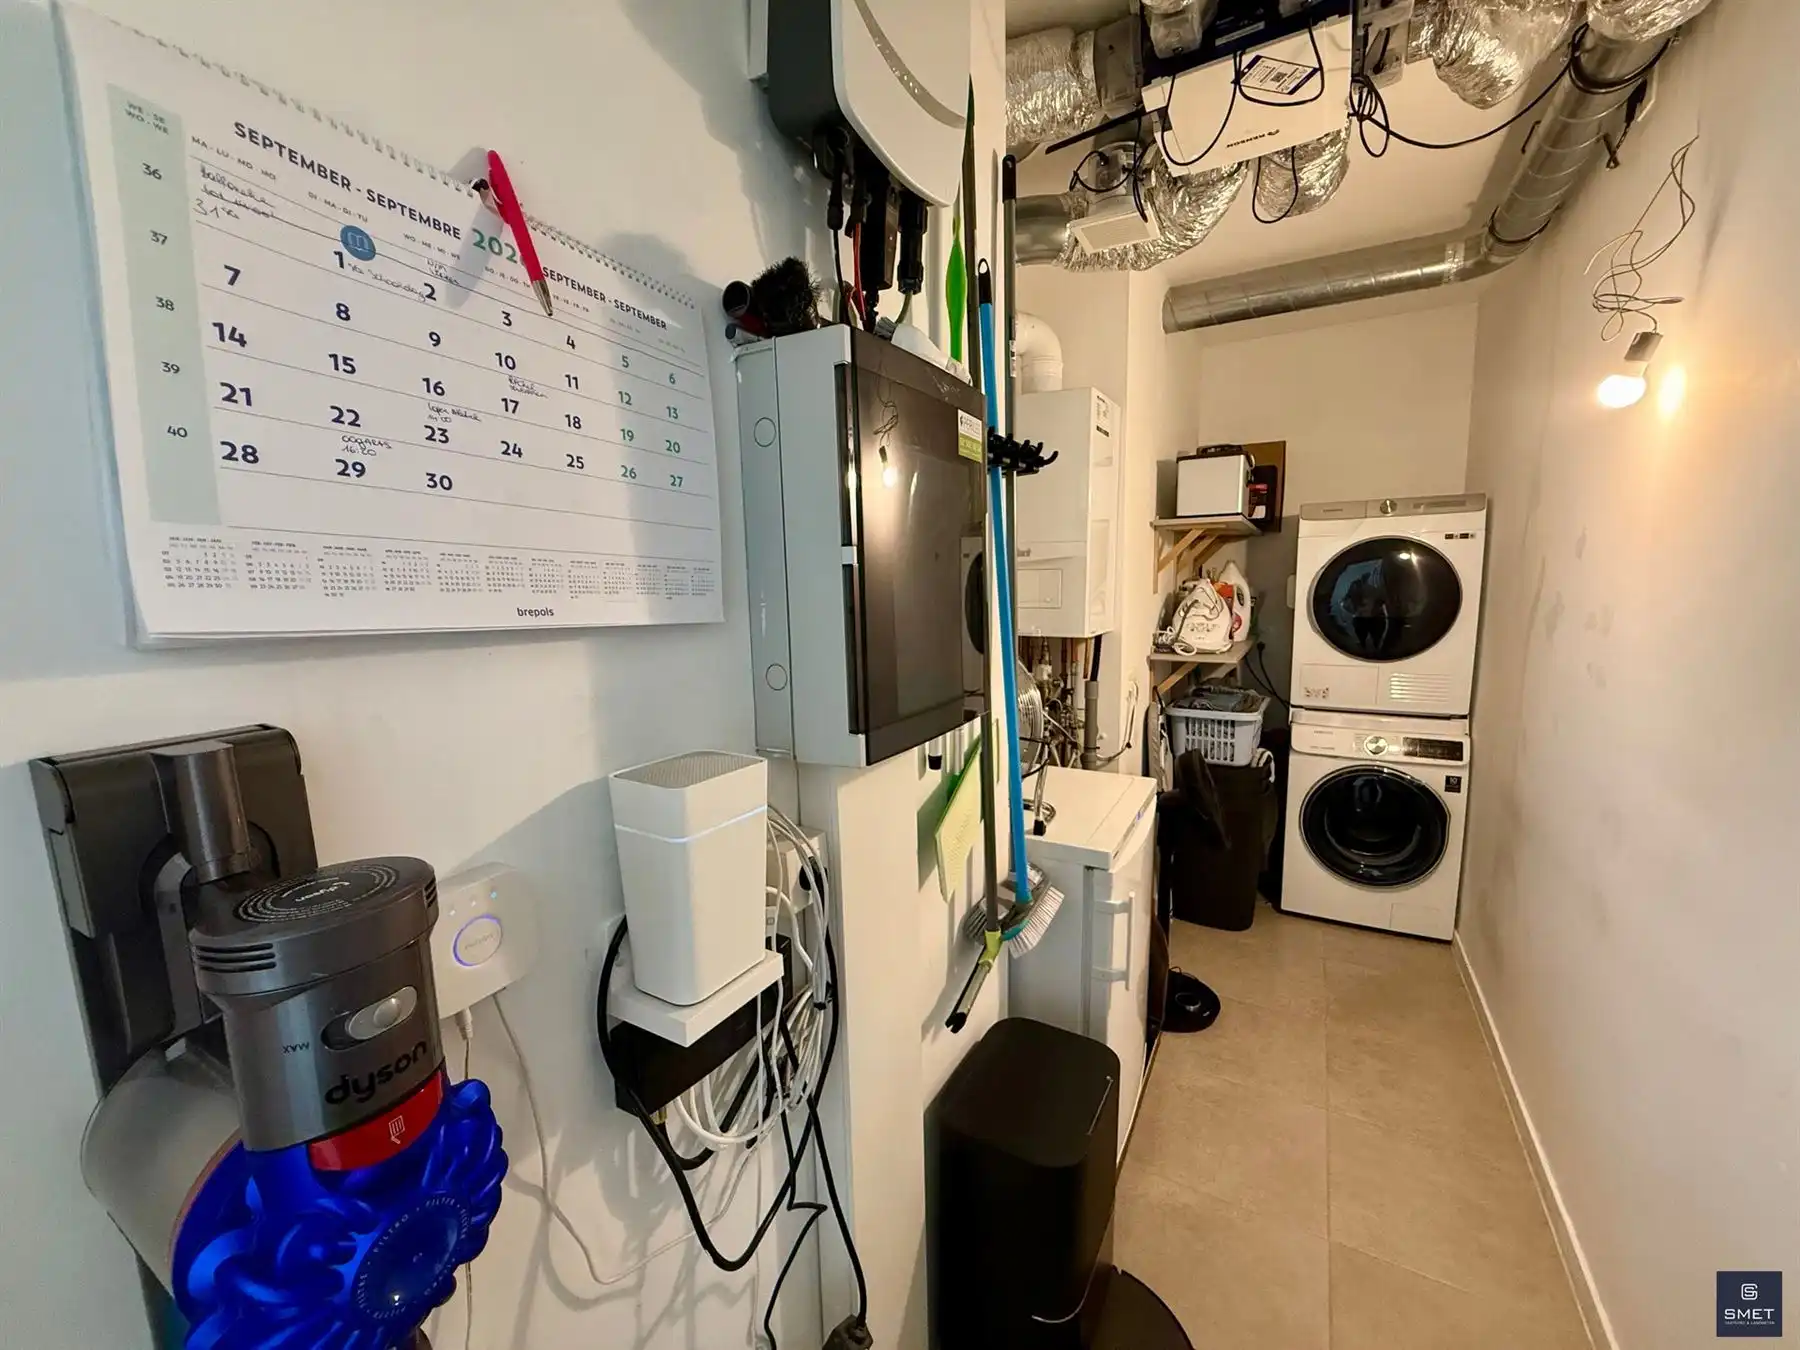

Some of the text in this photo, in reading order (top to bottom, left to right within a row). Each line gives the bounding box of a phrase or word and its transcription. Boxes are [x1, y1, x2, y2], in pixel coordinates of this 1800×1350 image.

[143, 163, 162, 181] 36
[234, 121, 352, 191] SEPTEMBER
[366, 189, 461, 240] SEPTEMBRE
[472, 228, 526, 265] 202
[542, 266, 606, 304] SEPTEMBER
[614, 299, 667, 330] SEPTEMBER
[150, 230, 167, 245] 37
[333, 250, 344, 269] 1
[224, 264, 241, 286] 7
[424, 283, 436, 301] 2
[156, 296, 175, 312] 38
[335, 303, 351, 321] 8
[502, 311, 512, 326] 3
[212, 321, 247, 348] 14
[428, 331, 441, 347] 9
[566, 336, 576, 350] 4
[161, 361, 180, 375] 39
[329, 353, 356, 374] 15
[495, 352, 516, 370] 10
[622, 355, 629, 368] 5
[565, 374, 579, 390] 11
[669, 373, 675, 384] 6
[220, 382, 252, 407] 21
[422, 378, 445, 396] 16
[501, 398, 519, 414] 17
[618, 391, 632, 406] 12
[330, 405, 361, 427] 22
[666, 406, 678, 419] 13
[565, 414, 581, 429] 18
[167, 425, 188, 438] 40
[424, 425, 449, 443] 23
[621, 428, 634, 442] 19
[220, 441, 259, 464] 28
[501, 441, 523, 458] 24
[666, 440, 680, 453] 20
[335, 458, 366, 478] 29
[566, 454, 584, 469] 25
[621, 465, 636, 479] 26
[426, 473, 452, 490] 30
[671, 475, 683, 487] 27
[517, 607, 554, 618] brepols
[282, 1041, 310, 1054] MAX
[324, 1040, 428, 1105] dyson
